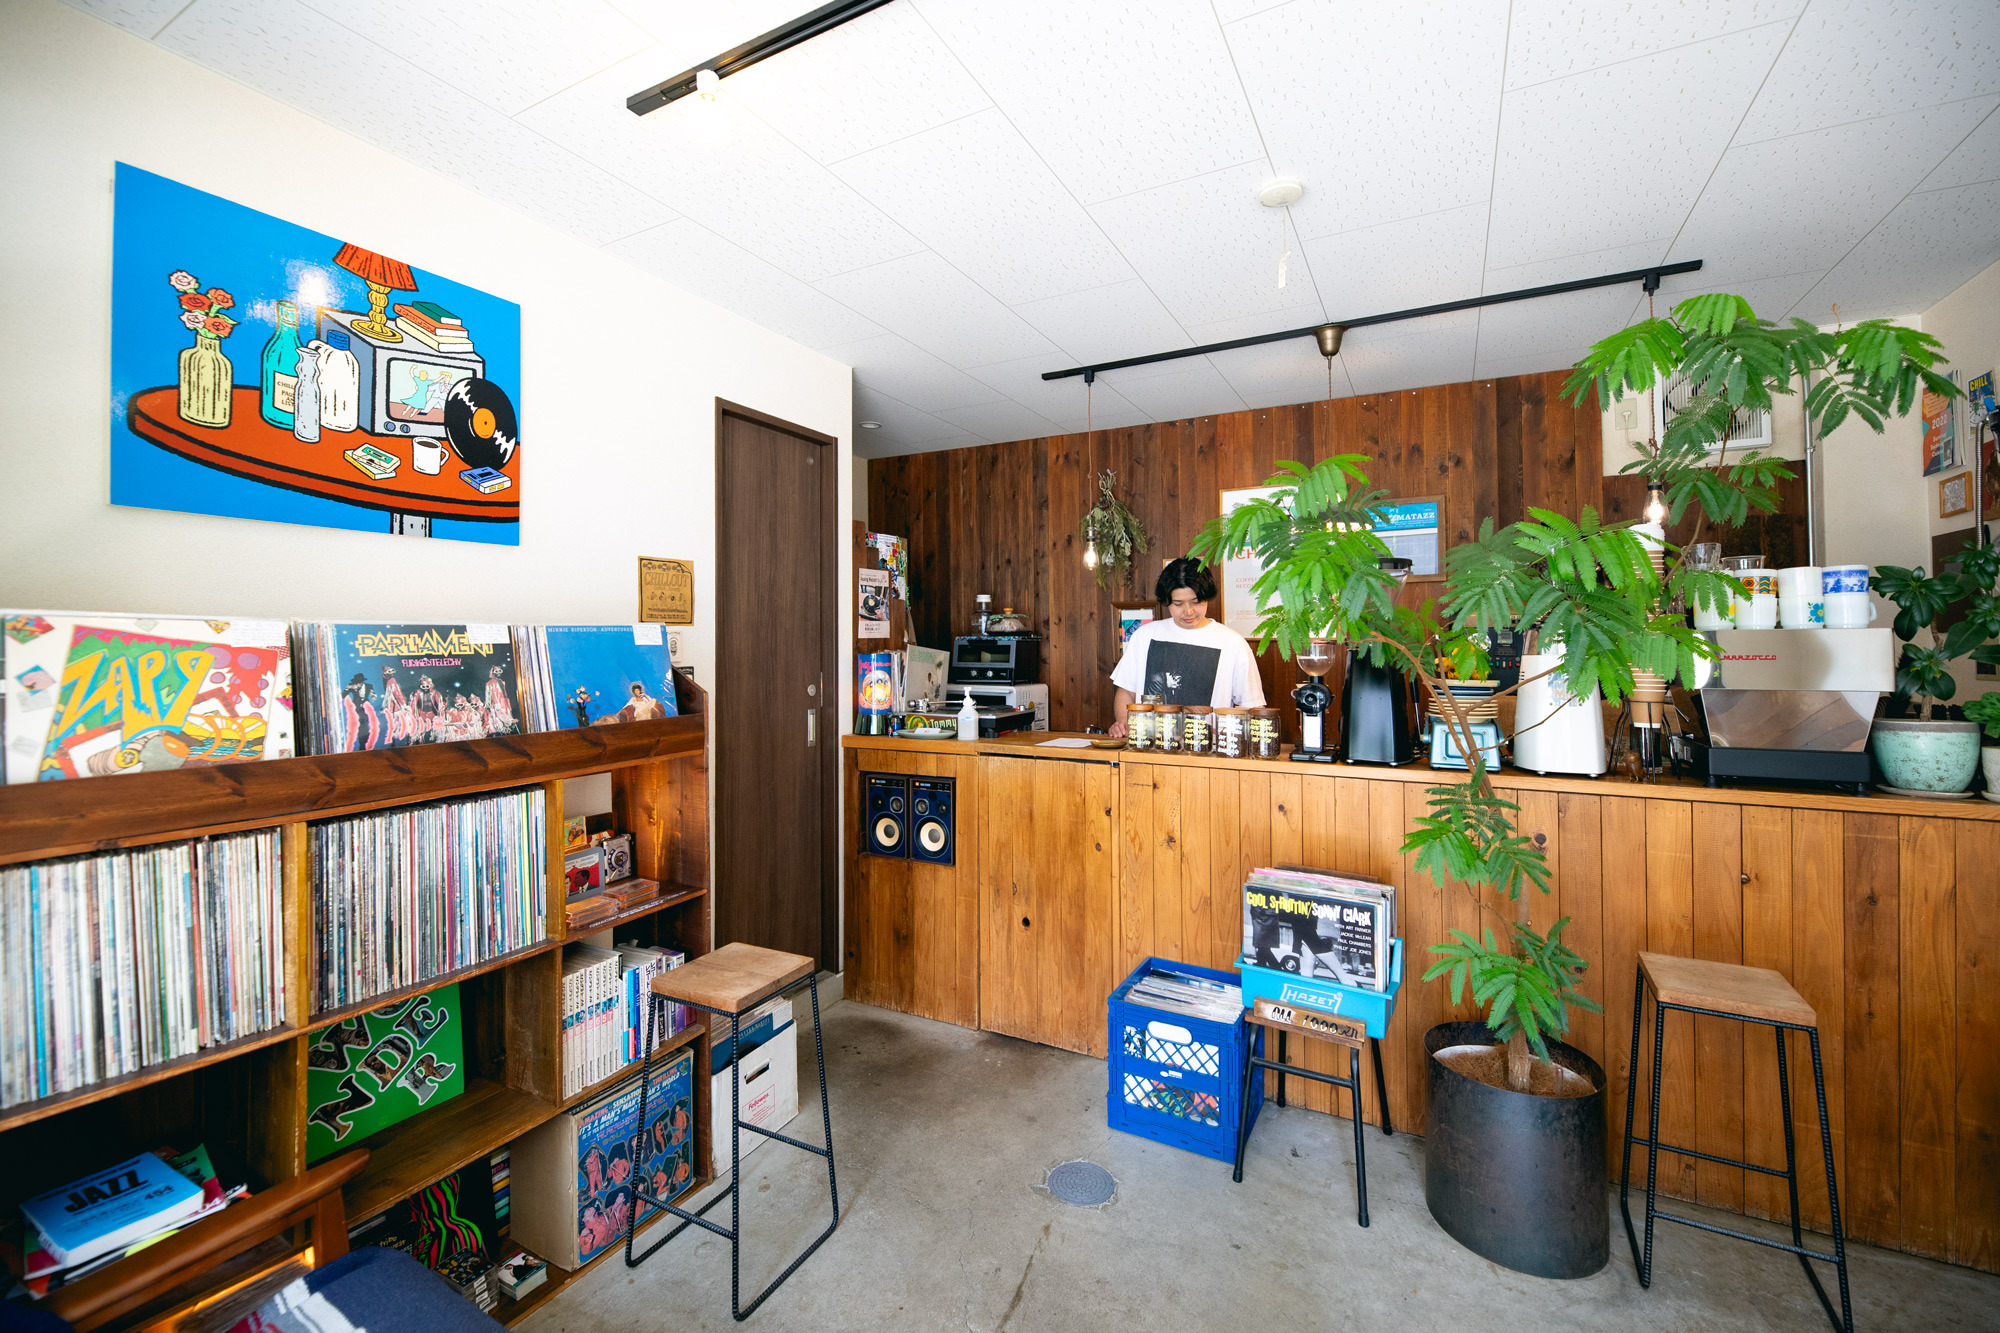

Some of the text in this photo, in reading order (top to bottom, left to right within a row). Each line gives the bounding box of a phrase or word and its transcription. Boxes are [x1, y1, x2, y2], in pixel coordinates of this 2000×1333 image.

[1932, 414, 1948, 430] 2022
[1246, 891, 1268, 910] COOL
[1343, 907, 1372, 927] CLARK
[1286, 989, 1336, 1006] HAZET
[652, 1066, 678, 1085] THRILLING
[63, 1169, 149, 1213] JAZZ
